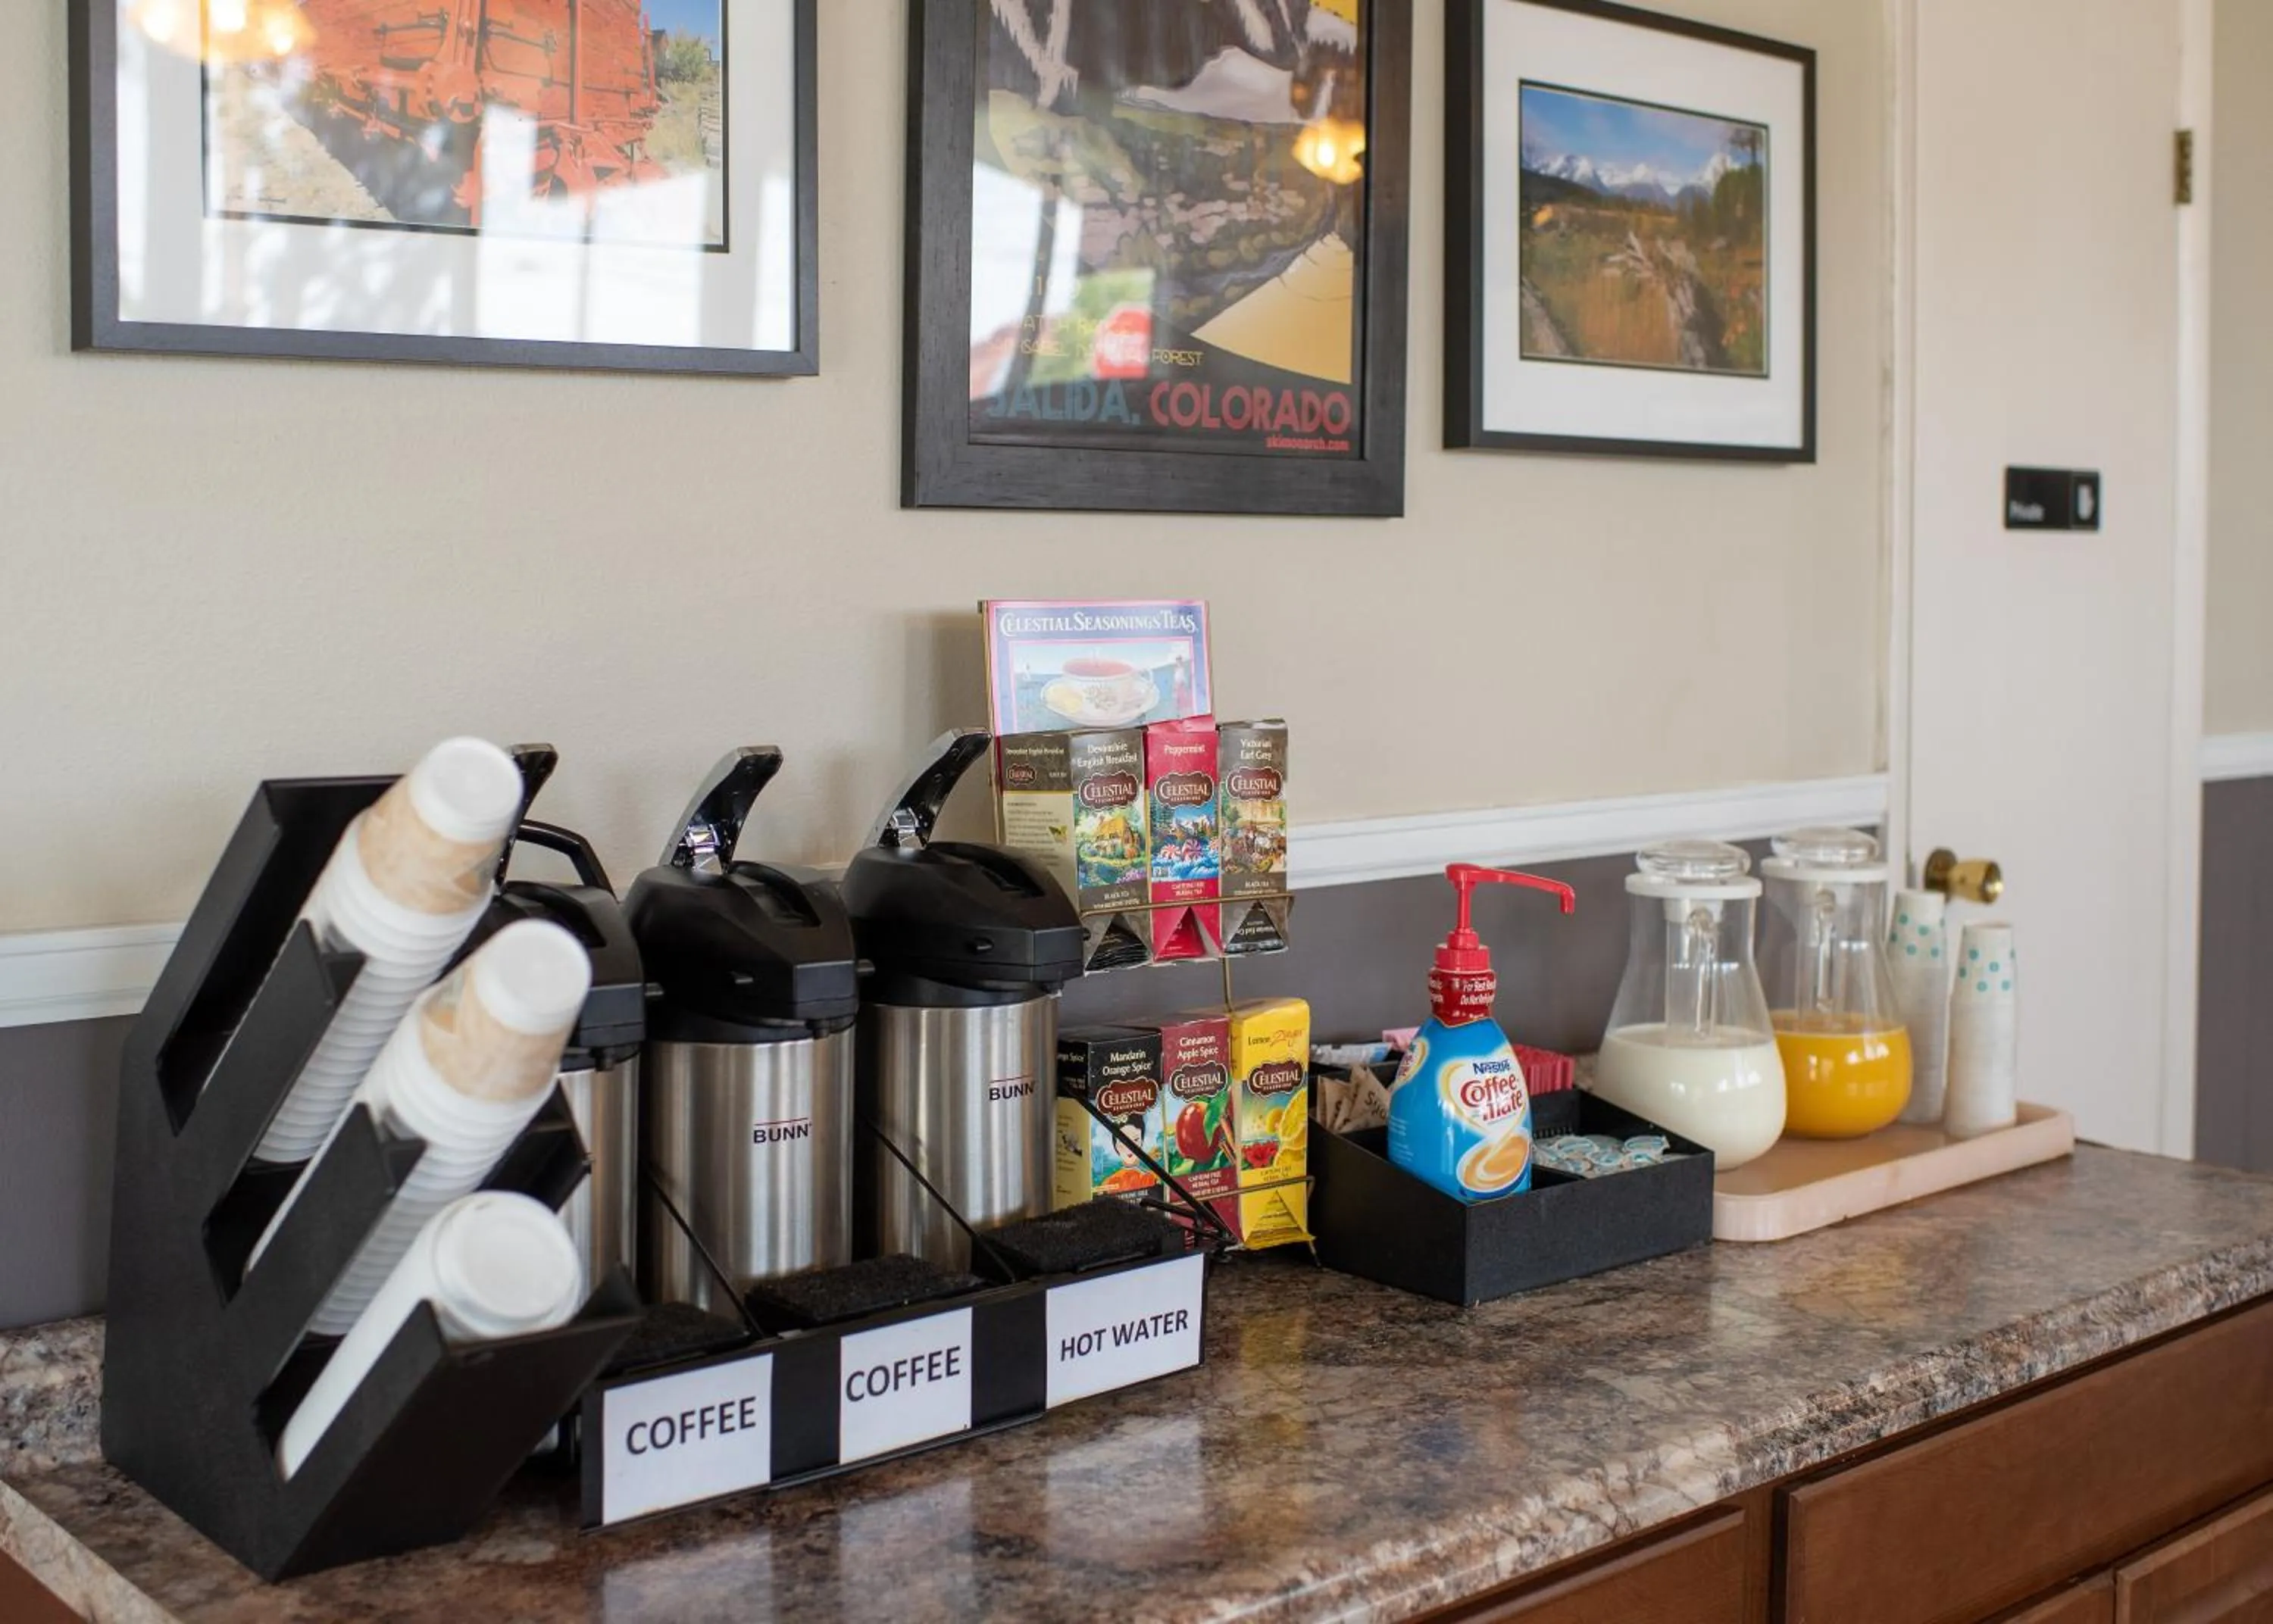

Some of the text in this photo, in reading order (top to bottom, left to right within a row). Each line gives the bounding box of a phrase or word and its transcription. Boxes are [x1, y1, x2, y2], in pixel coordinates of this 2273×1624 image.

[1153, 348, 1204, 365] FOREST
[1150, 381, 1352, 435] COLORADO
[999, 610, 1196, 637] CELESTIAL SEASONINGS TEAS
[1164, 745, 1205, 756] Peppermint
[1083, 782, 1134, 801] CELESTIAL
[1160, 781, 1208, 799] CELESTIAL
[1231, 775, 1279, 793] CELESTIAL
[1179, 1035, 1216, 1047] Cinnamon
[1110, 1049, 1146, 1063] Mandarin
[1177, 1046, 1218, 1060] Apple Spice
[1102, 1061, 1152, 1076] Orange Spice
[1175, 1072, 1224, 1092] CELESTIAL
[1252, 1069, 1300, 1088] CELESTIAL
[989, 1081, 1035, 1101] BUNN
[1101, 1089, 1154, 1108] CELESTIAL
[1460, 1074, 1517, 1107] Coffee
[753, 1123, 809, 1144] BUNN
[1060, 1308, 1190, 1363] HOT WATER
[845, 1345, 962, 1404] COFFEE
[625, 1395, 758, 1456] COFFEE
